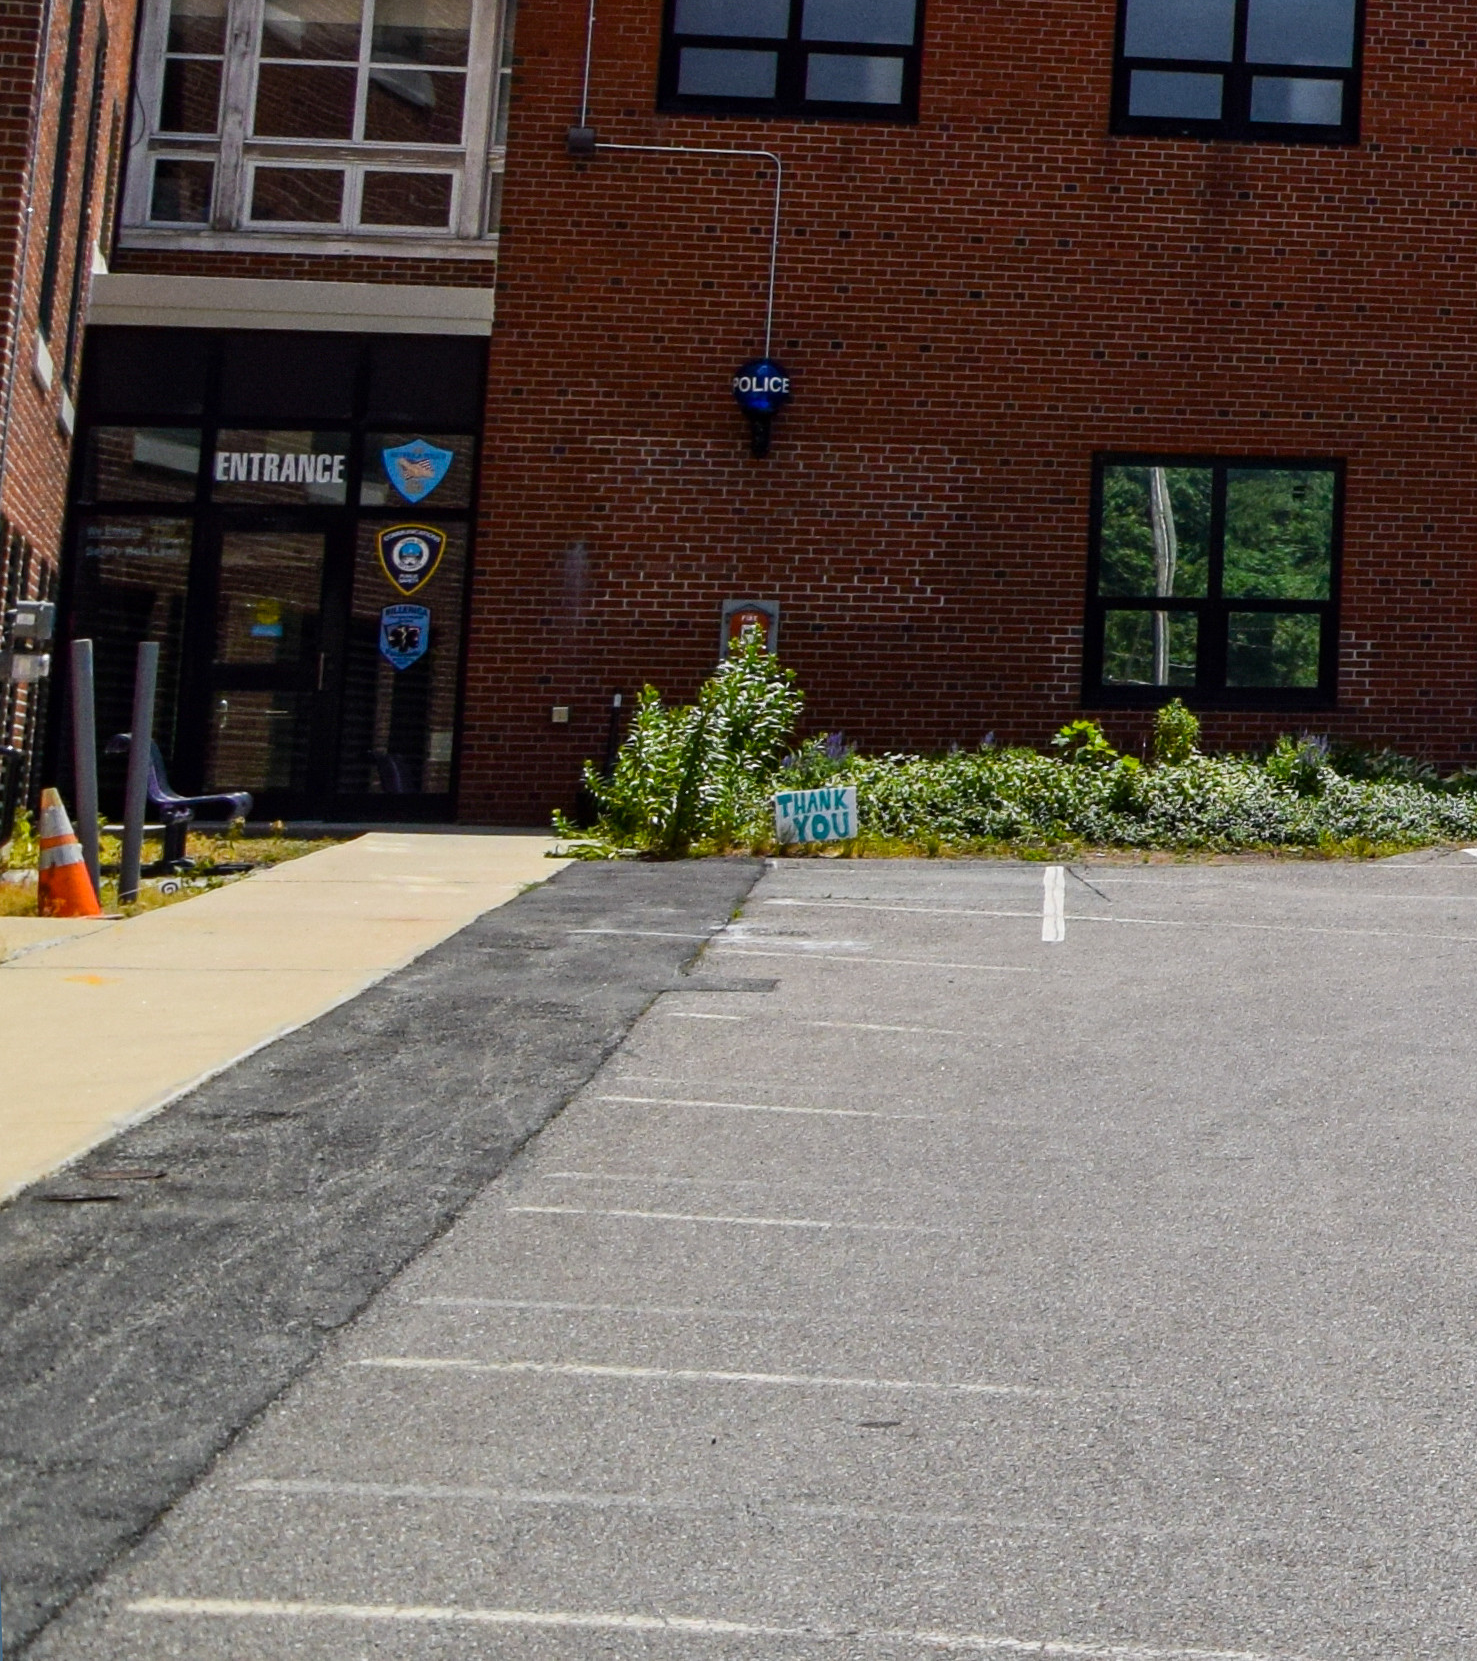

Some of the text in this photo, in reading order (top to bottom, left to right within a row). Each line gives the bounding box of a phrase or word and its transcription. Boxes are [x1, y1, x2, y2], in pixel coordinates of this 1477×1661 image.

[733, 376, 790, 393] POLICE
[216, 452, 345, 483] ENTRANCE
[776, 789, 849, 818] THANK
[793, 812, 849, 842] YOU
